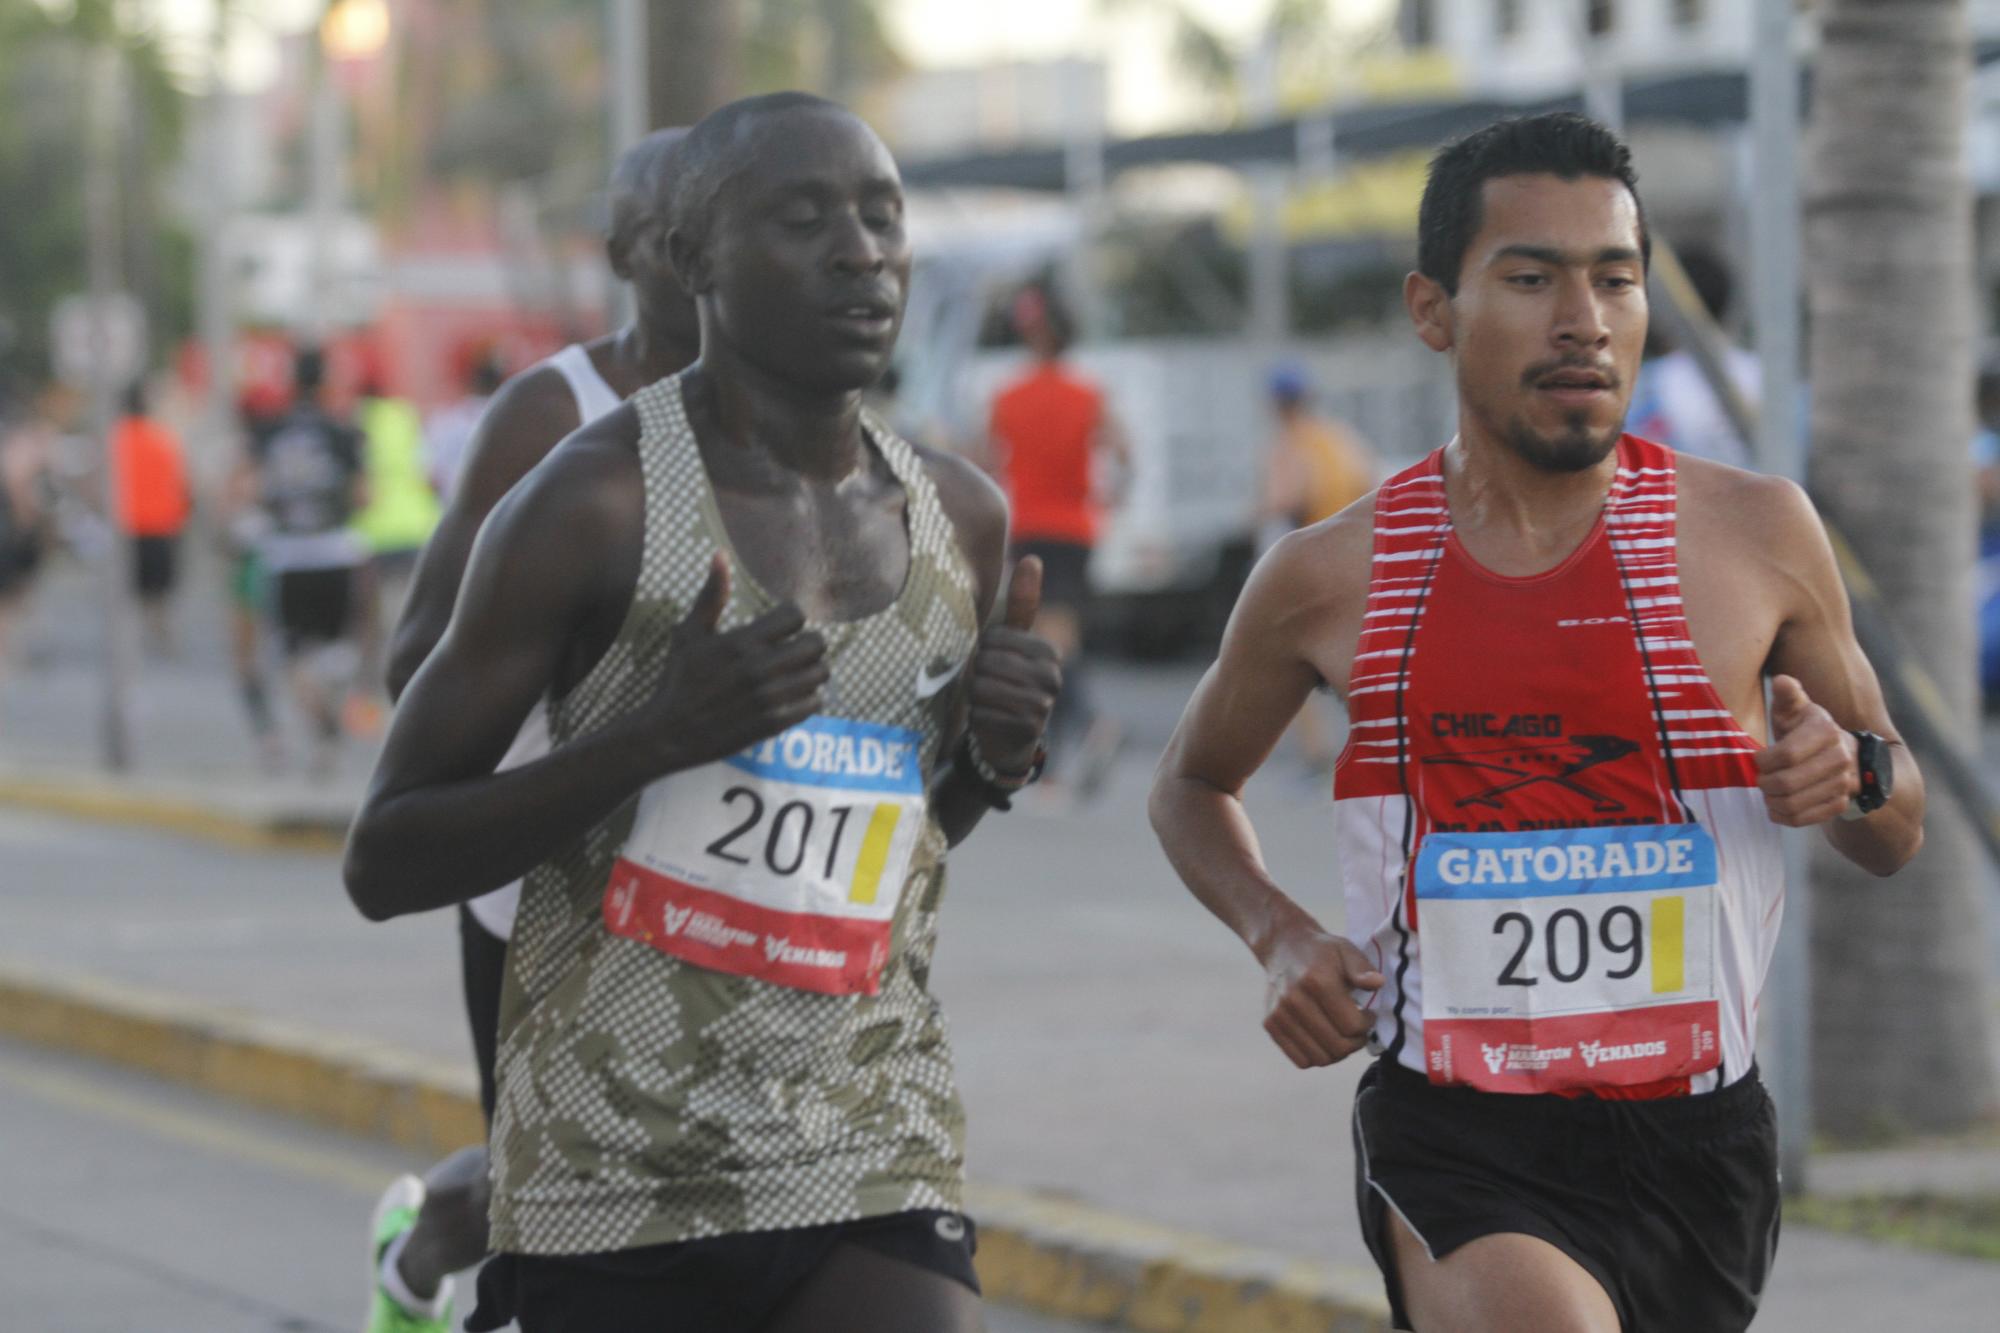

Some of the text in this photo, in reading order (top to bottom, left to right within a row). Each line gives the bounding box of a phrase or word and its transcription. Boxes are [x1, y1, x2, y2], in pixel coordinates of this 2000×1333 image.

[1432, 712, 1562, 738] CHICAGO
[706, 786, 852, 880] 201
[1437, 839, 1694, 885] GATORADE
[1492, 905, 1643, 987] 209
